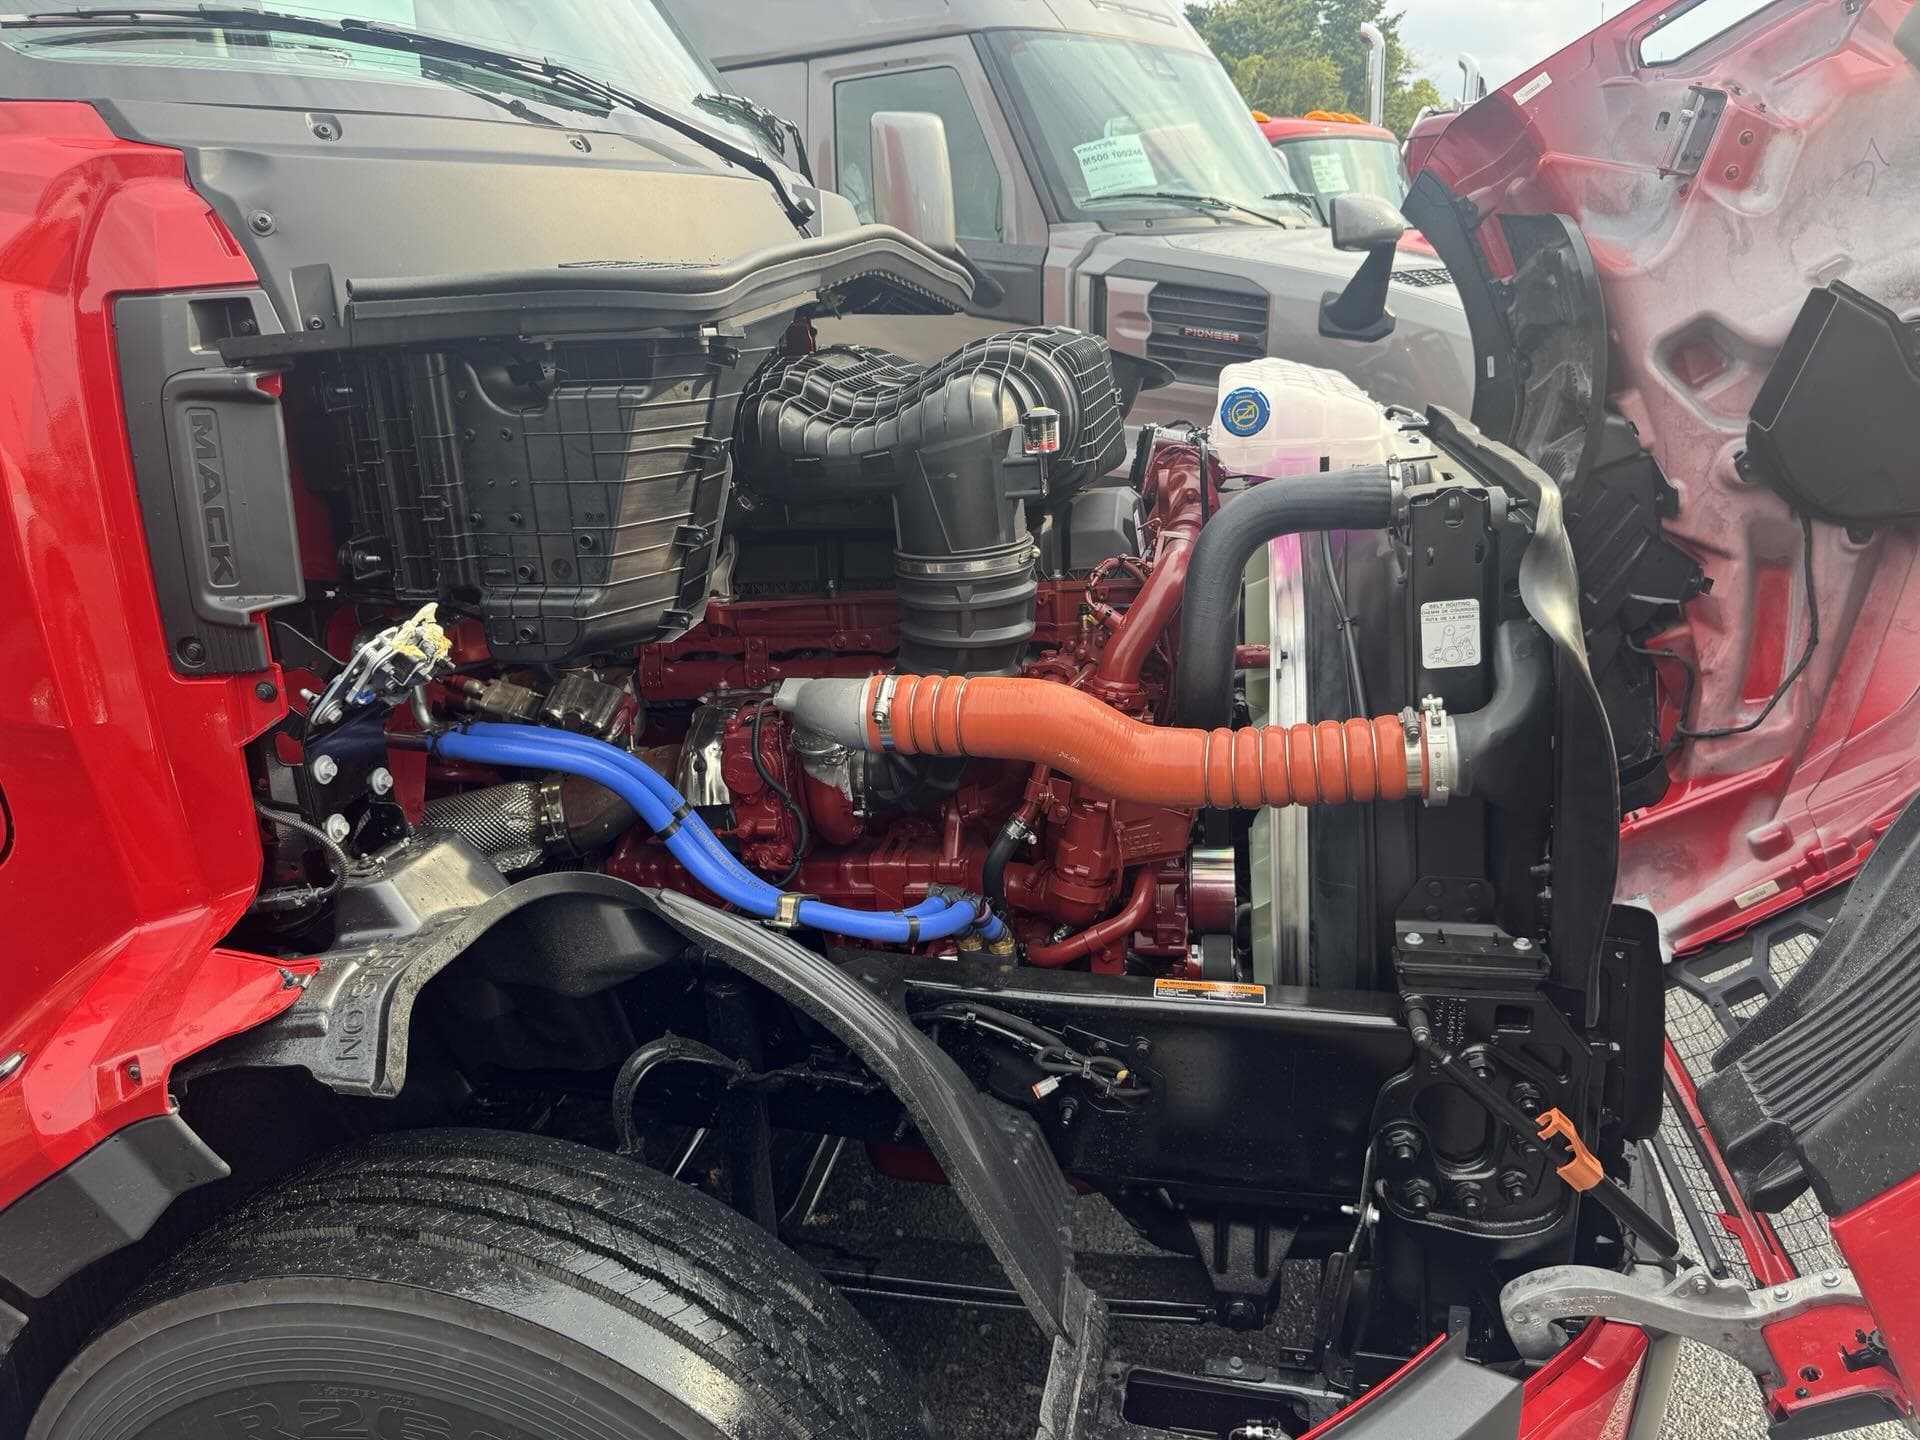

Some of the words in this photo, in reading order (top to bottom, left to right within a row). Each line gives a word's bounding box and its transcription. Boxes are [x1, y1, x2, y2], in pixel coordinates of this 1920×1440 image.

[1082, 153, 1109, 167] M500
[1184, 327, 1239, 342] PIONEER
[190, 412, 235, 584] MACK
[335, 1010, 366, 1061] NO
